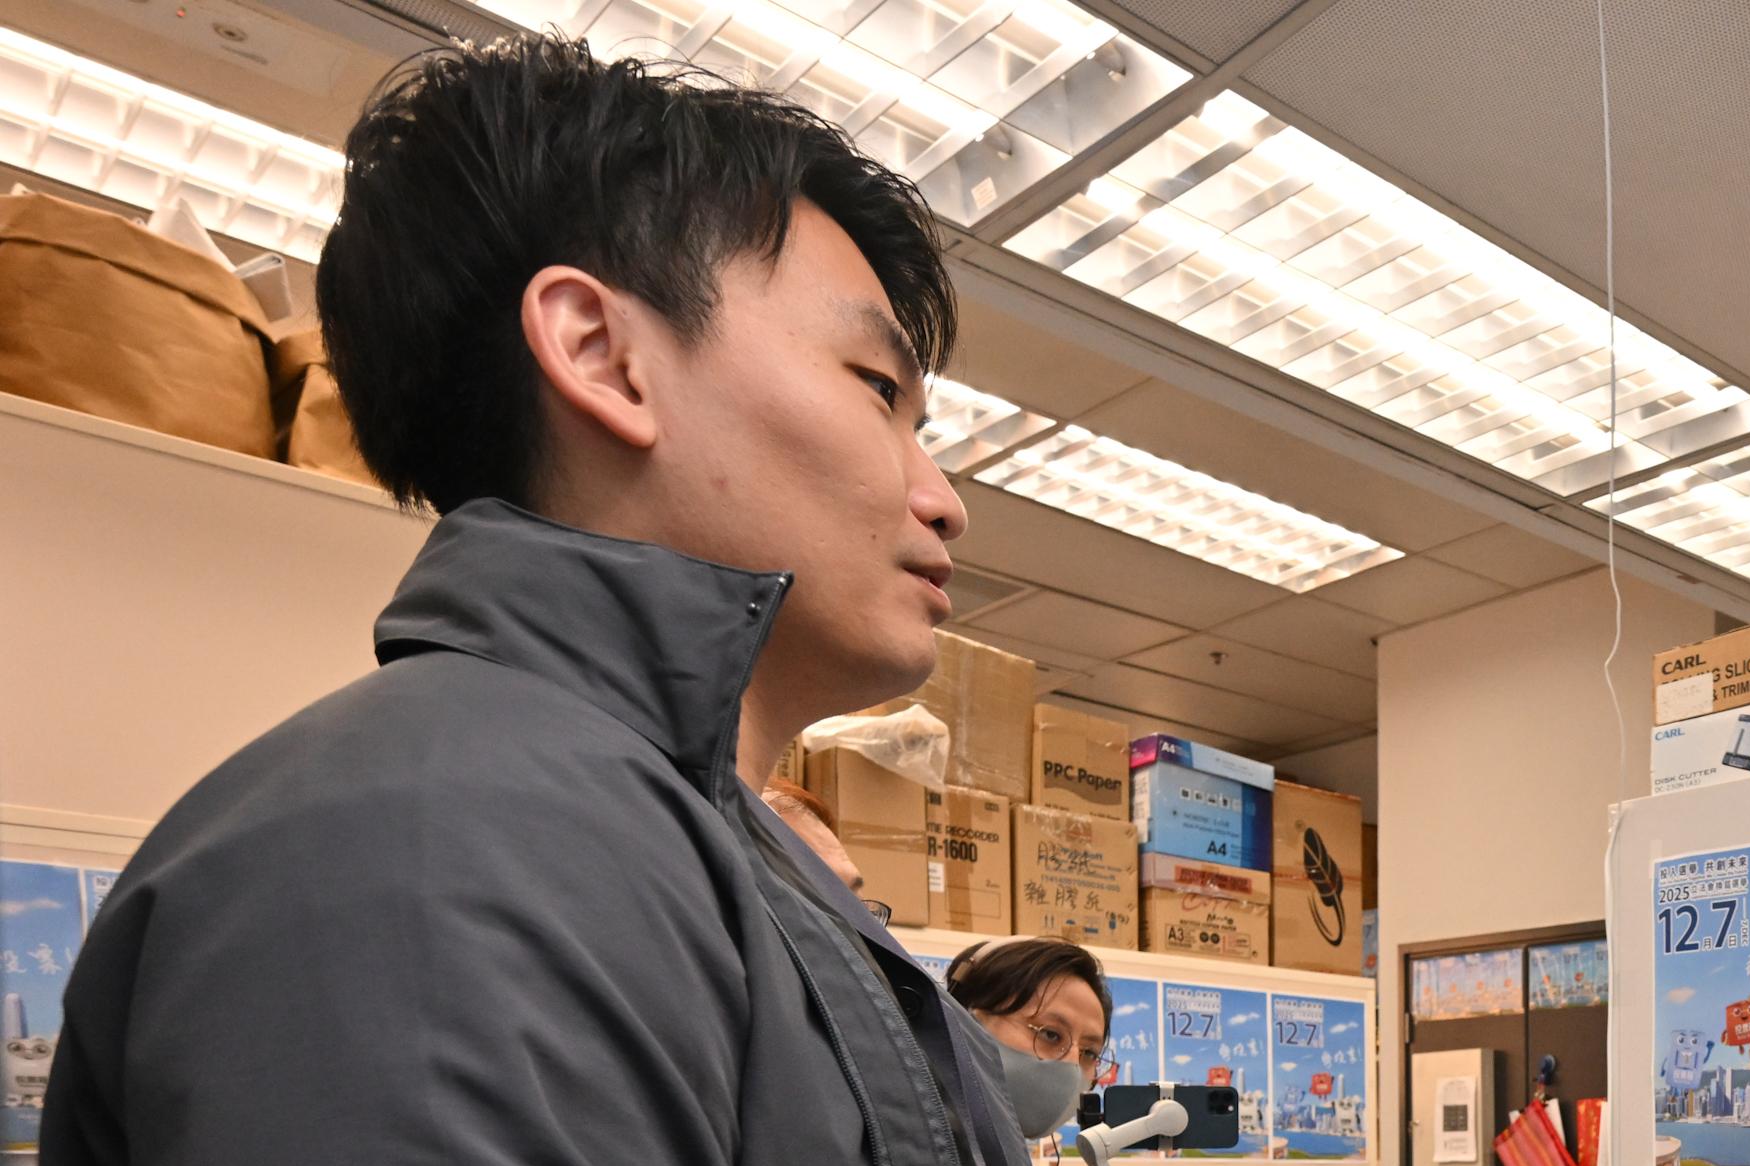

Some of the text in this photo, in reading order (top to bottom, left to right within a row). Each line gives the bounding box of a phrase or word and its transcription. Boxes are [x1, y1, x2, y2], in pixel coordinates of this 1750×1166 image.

[1661, 653, 1707, 676] CARL
[1654, 727, 1686, 742] CARL
[1161, 741, 1176, 754] A4
[1043, 759, 1123, 791] PPC Paper
[1678, 767, 1717, 781] CUTTER
[945, 824, 1000, 843] RECORDER
[927, 836, 978, 863] R-1600
[1207, 840, 1227, 856] A4
[1659, 886, 1690, 904] 2025
[1168, 926, 1184, 942] A3
